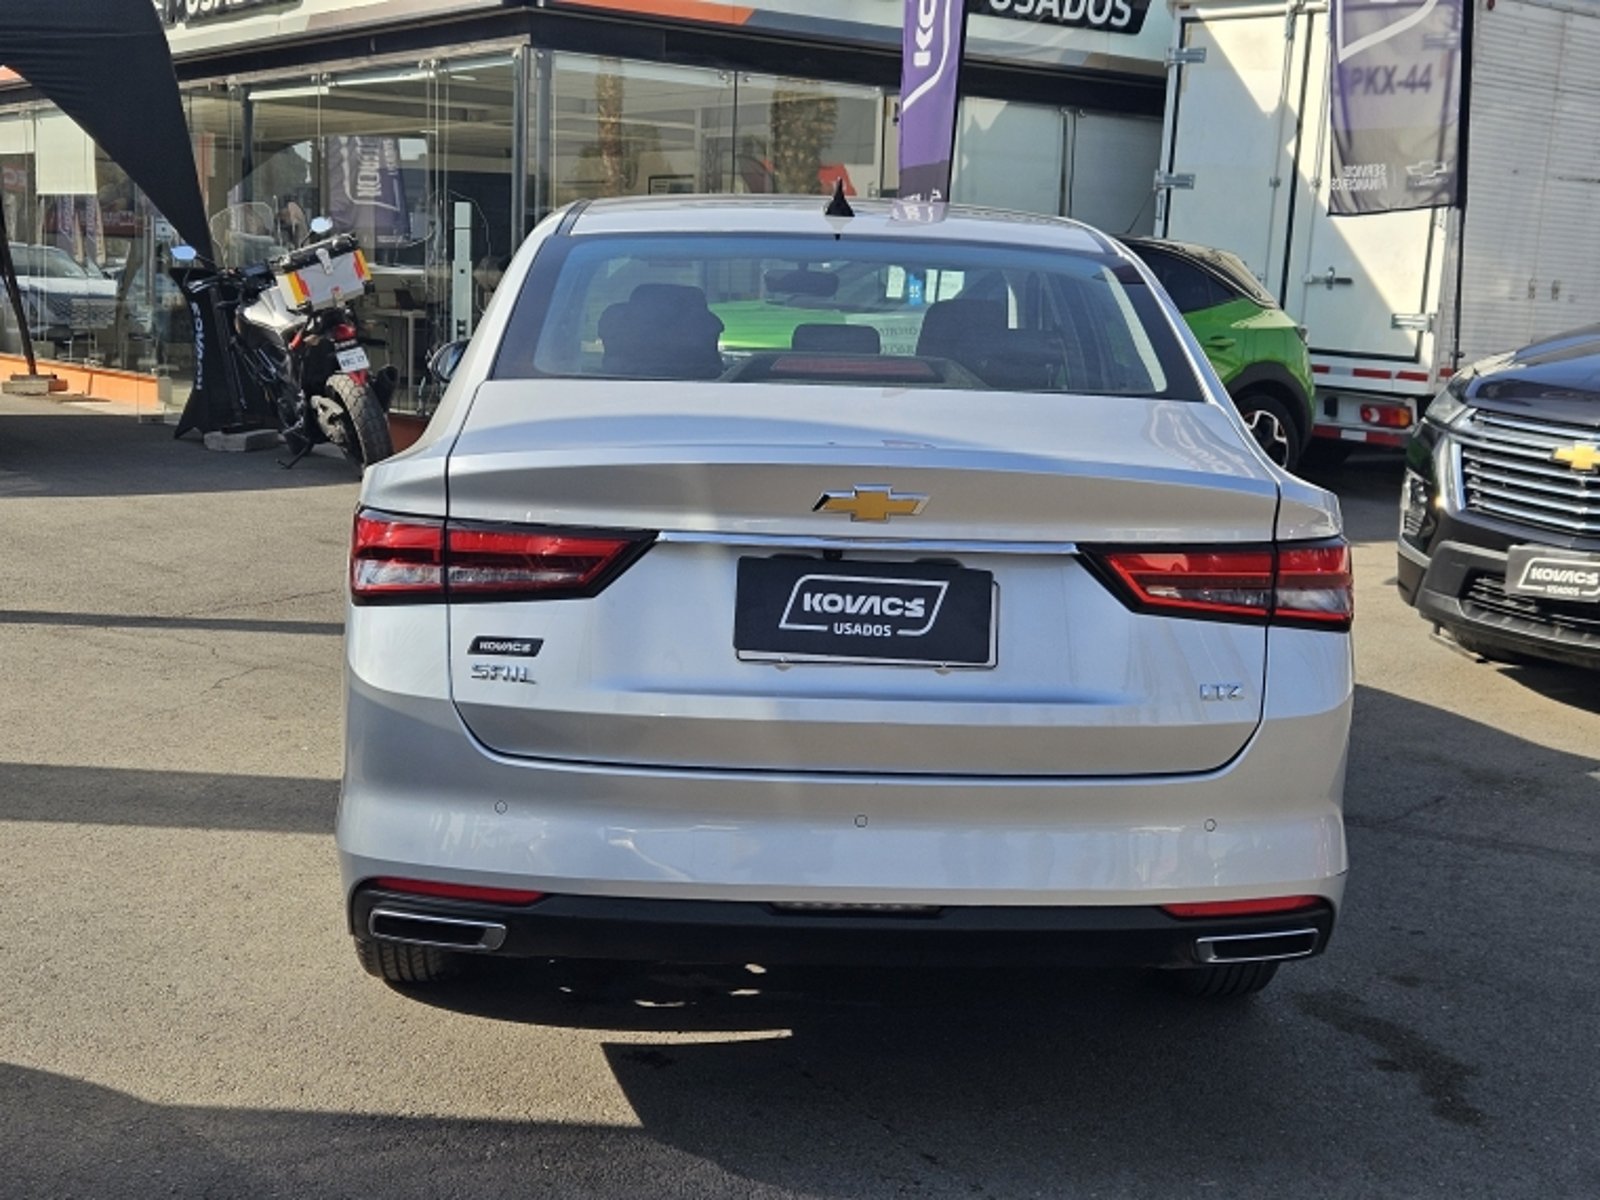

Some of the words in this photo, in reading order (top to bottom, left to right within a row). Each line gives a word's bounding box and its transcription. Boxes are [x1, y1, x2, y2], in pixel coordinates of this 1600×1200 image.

[1332, 63, 1433, 98] PKX-44
[1530, 567, 1599, 586] KOVACS
[803, 592, 926, 618] KOVACS
[833, 622, 892, 637] USADOS
[480, 641, 531, 653] KOVACS
[471, 664, 536, 685] SAIL
[1200, 683, 1244, 701] LTZ
